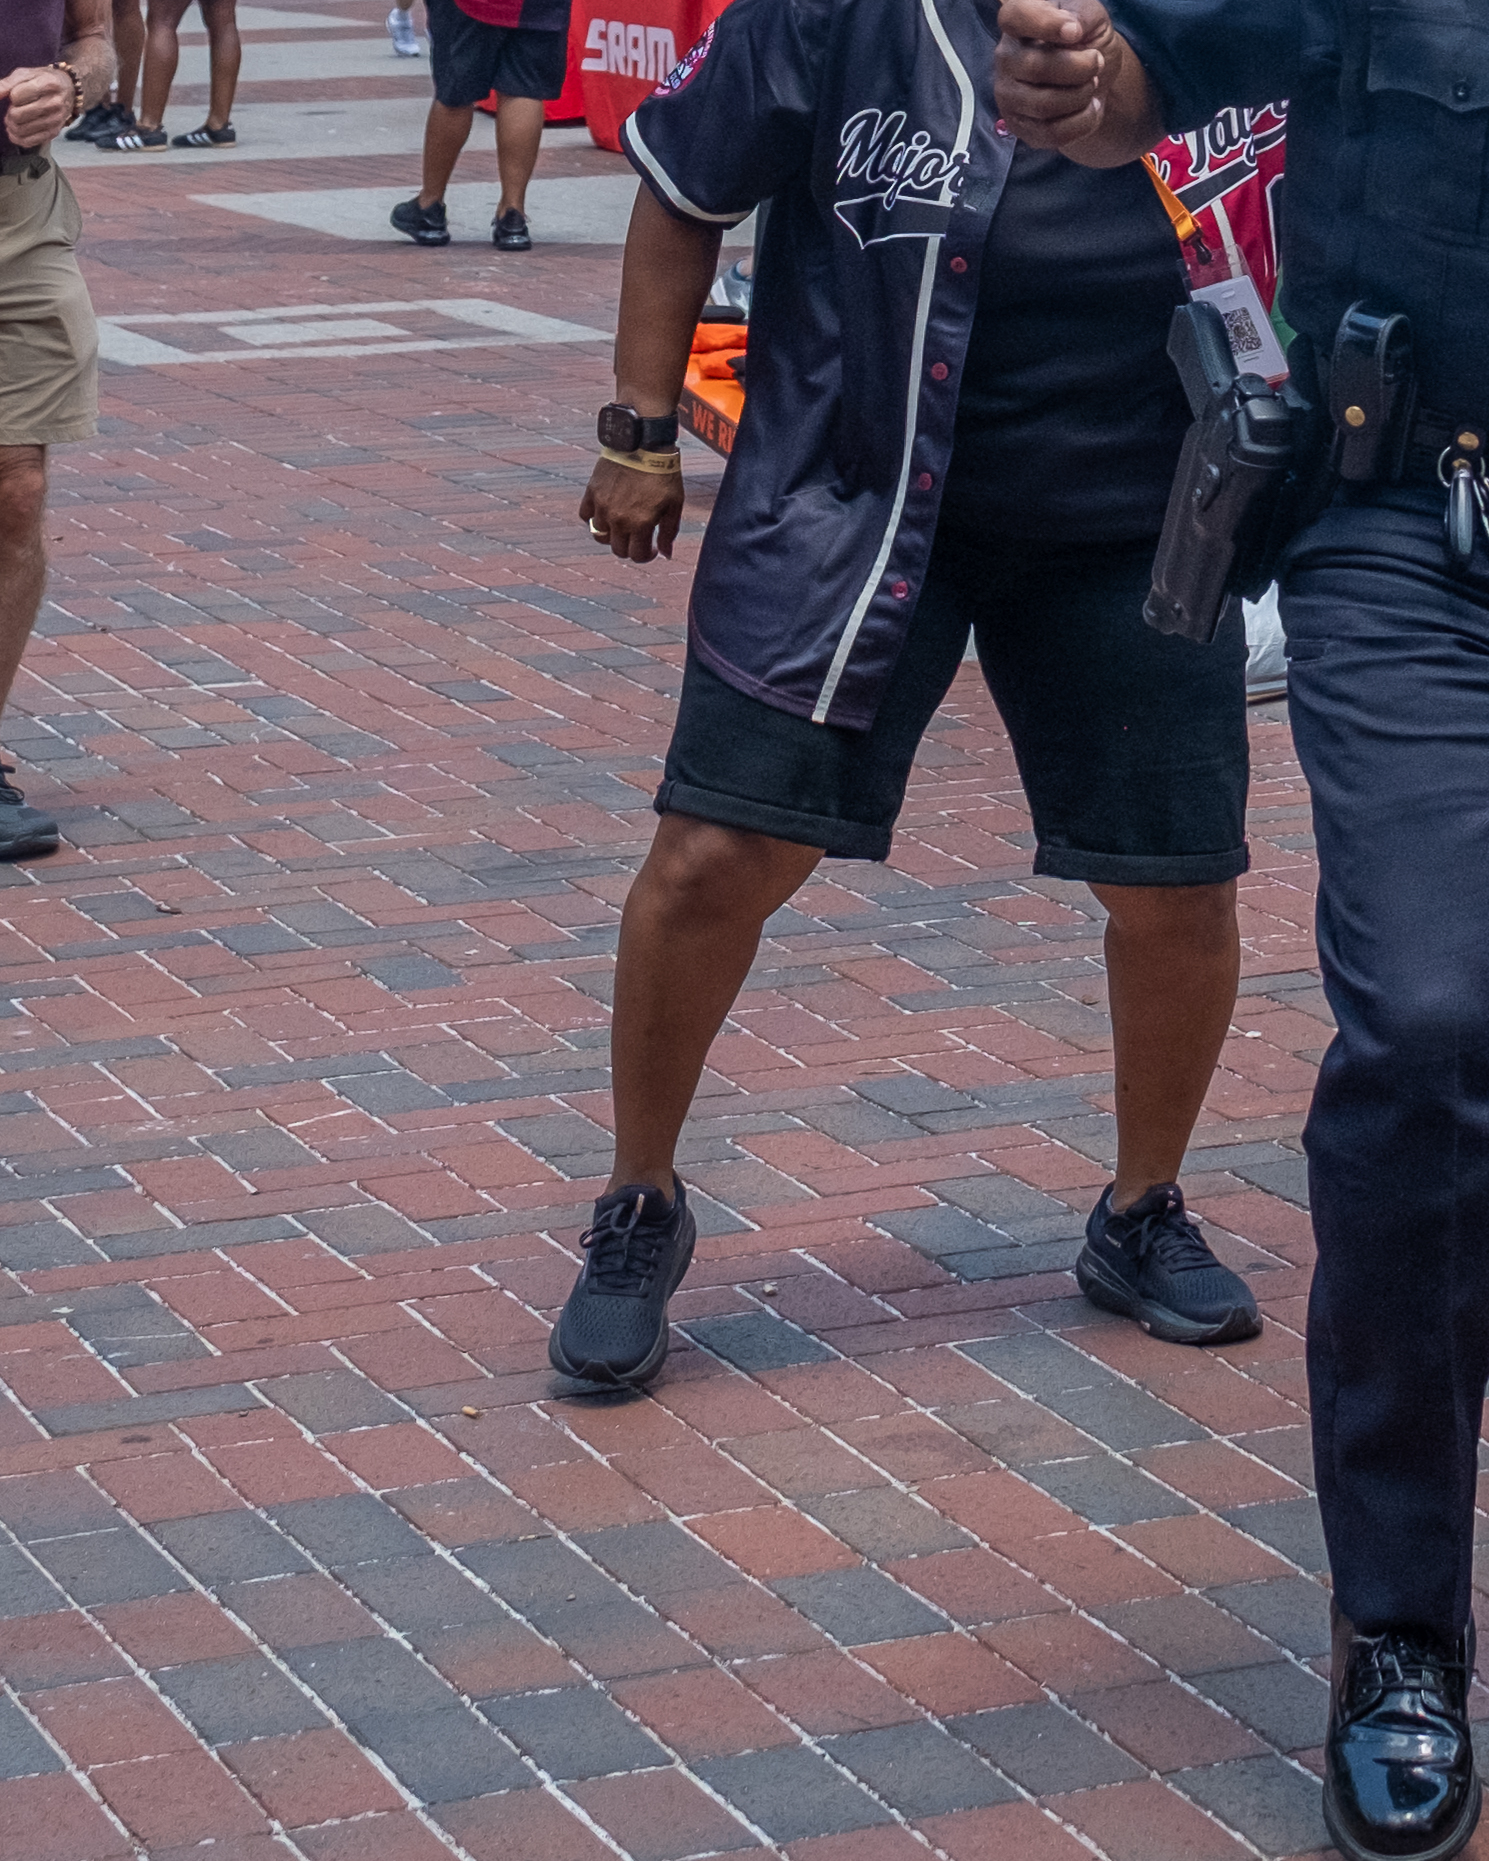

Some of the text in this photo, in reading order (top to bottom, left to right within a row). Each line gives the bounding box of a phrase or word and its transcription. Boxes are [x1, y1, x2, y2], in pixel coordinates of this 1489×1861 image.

[581, 18, 677, 83] SRAM
[836, 108, 970, 211] Major
[692, 401, 714, 440] WE
